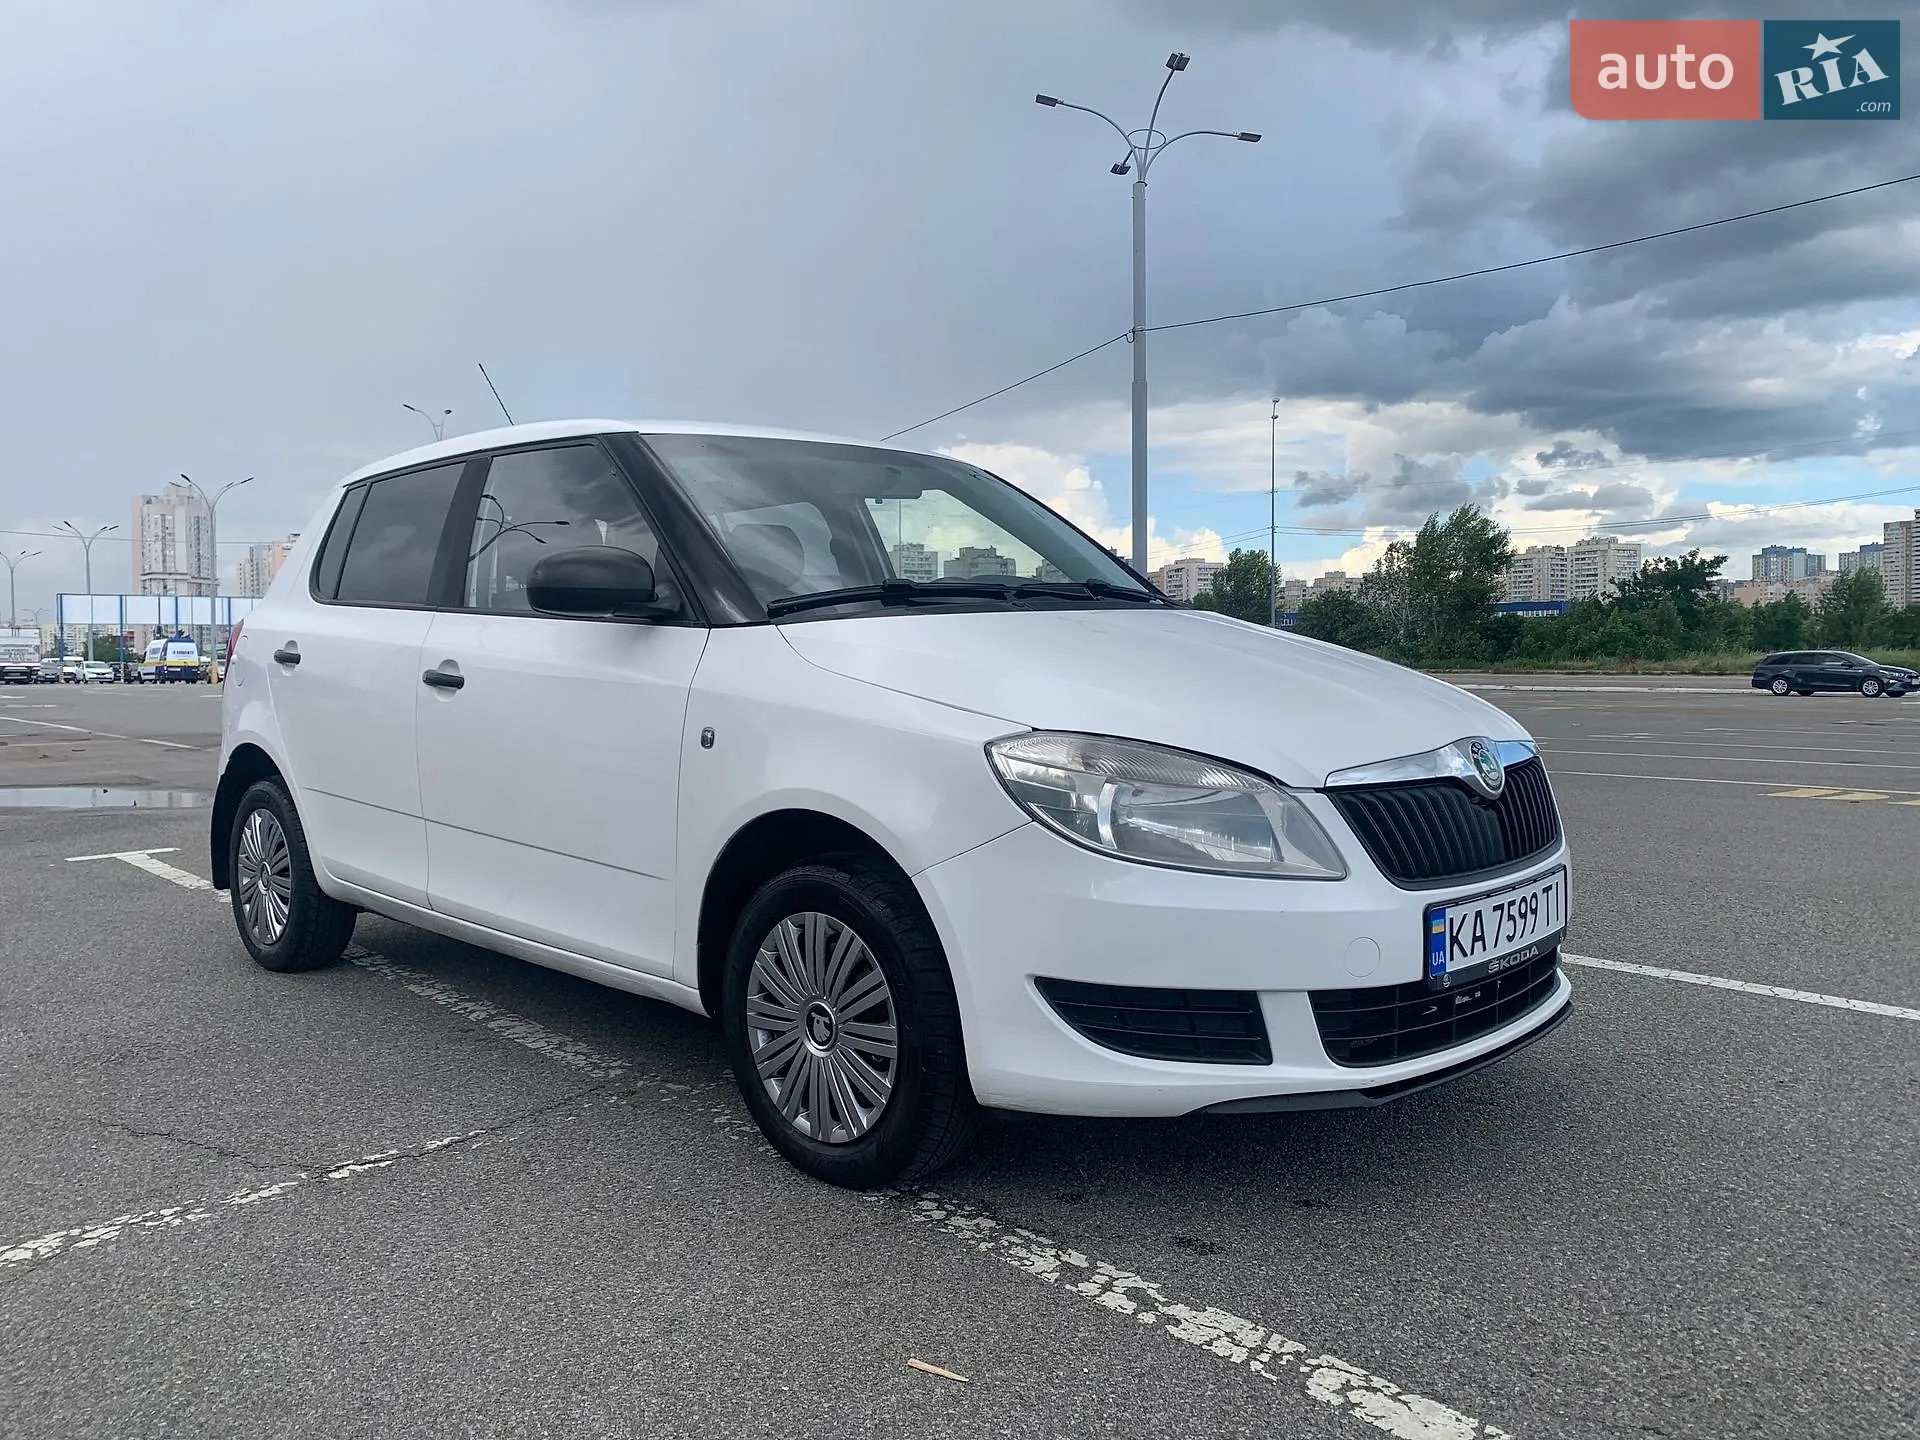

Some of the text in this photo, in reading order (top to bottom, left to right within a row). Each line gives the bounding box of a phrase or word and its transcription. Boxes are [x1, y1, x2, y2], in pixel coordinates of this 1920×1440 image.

[1449, 881, 1560, 962] KA 7599 TI
[1432, 951, 1445, 966] UA
